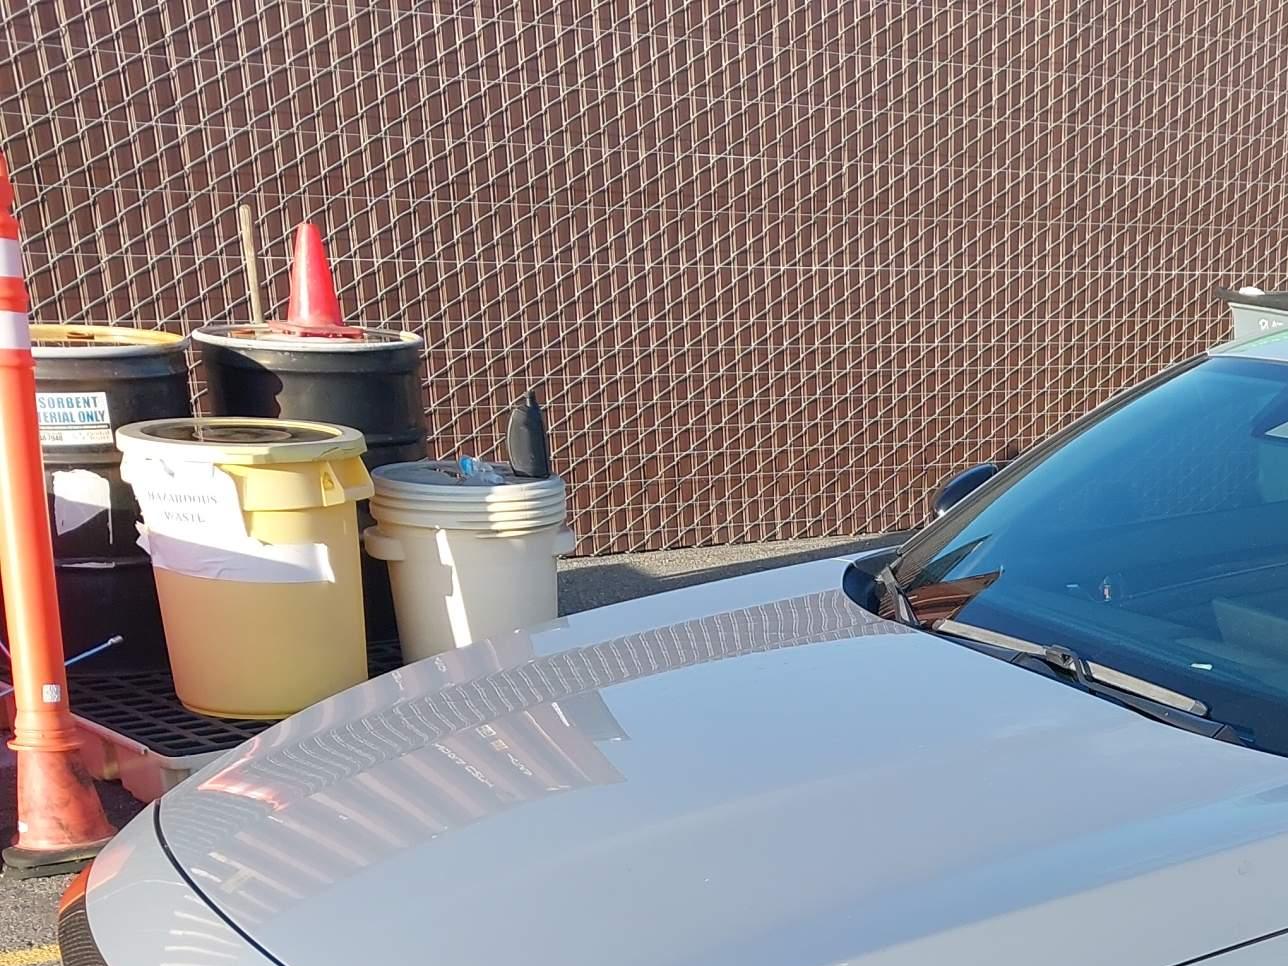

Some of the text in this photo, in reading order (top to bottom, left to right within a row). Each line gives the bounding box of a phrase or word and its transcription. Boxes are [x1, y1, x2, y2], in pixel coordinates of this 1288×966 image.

[78, 410, 105, 423] ONLY
[147, 490, 218, 505] HAZARDOUS
[163, 511, 206, 523] WASTE
